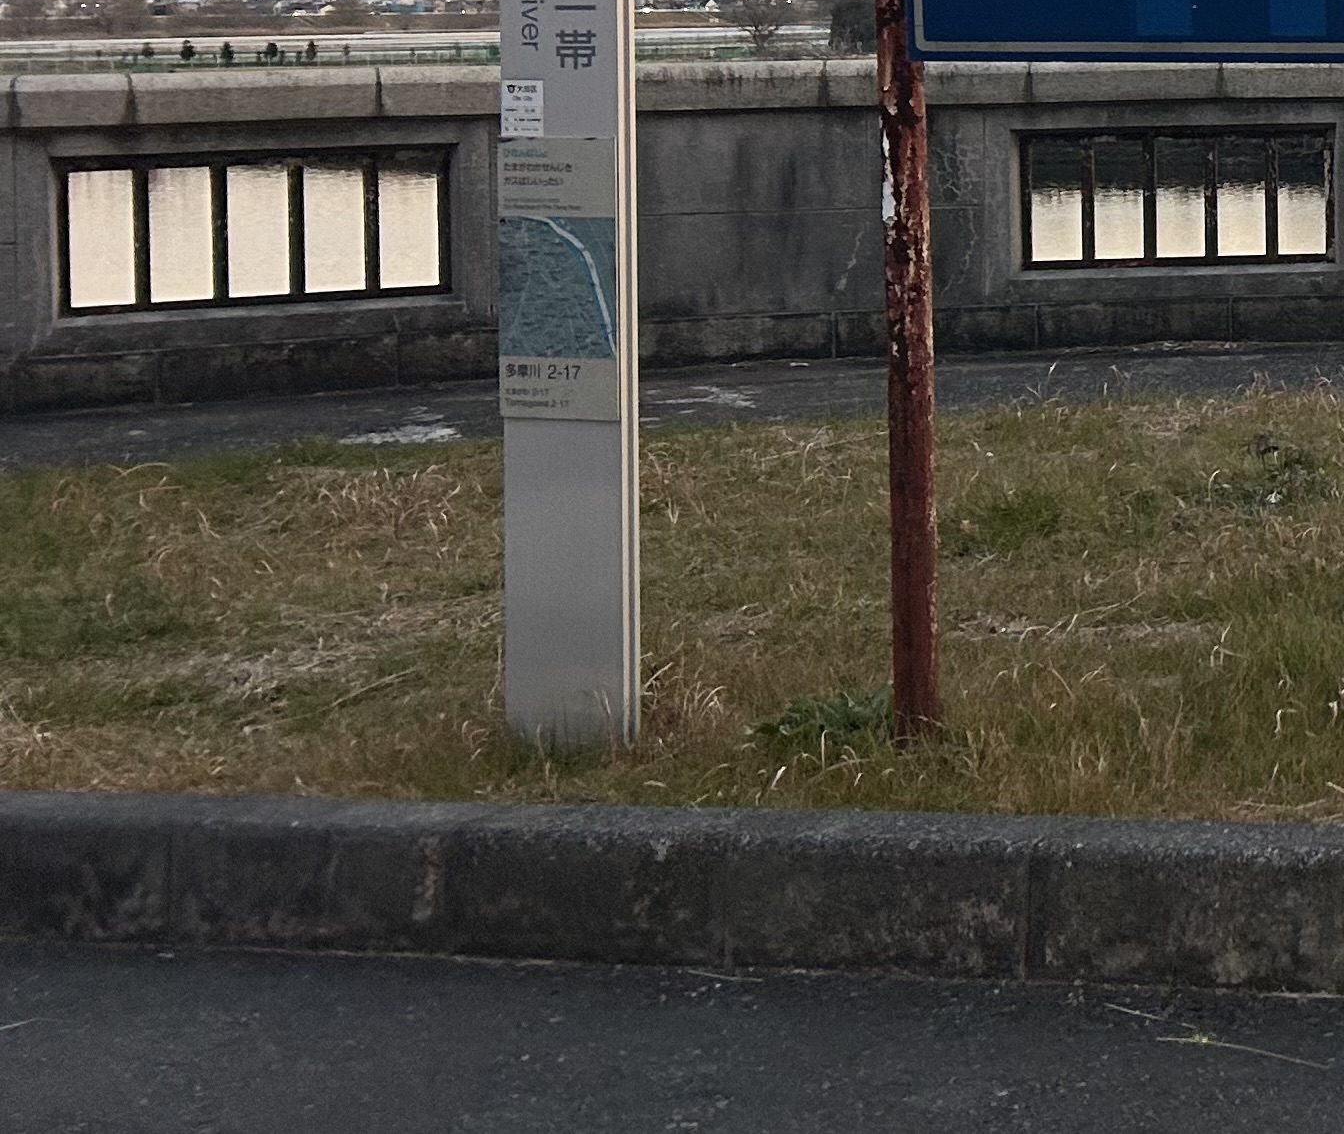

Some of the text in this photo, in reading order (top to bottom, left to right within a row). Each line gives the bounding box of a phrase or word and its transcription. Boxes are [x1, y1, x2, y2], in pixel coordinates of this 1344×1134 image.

[505, 363, 581, 380] 多摩川 2-17
